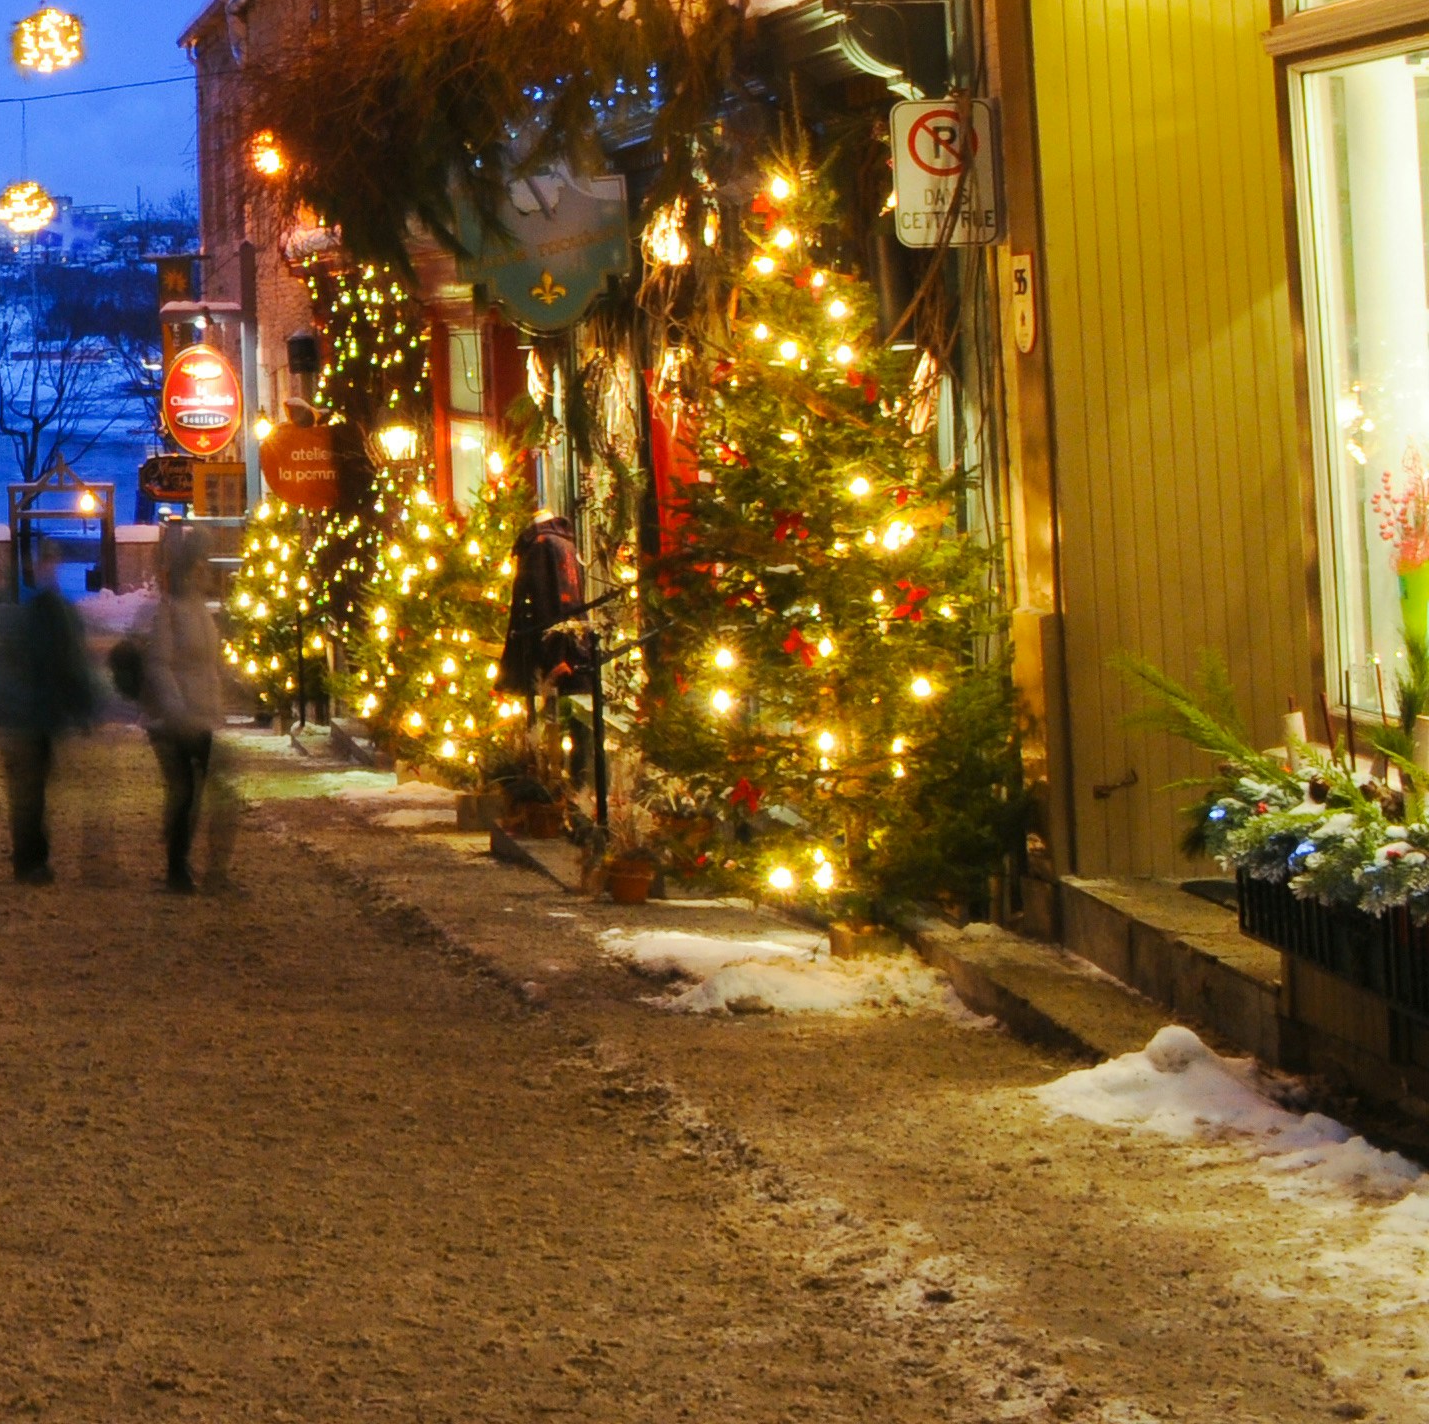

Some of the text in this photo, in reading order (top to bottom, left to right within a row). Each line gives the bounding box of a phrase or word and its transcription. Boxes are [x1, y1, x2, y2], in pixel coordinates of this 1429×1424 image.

[923, 187, 970, 206] DAS
[901, 210, 953, 230] CETT
[290, 446, 332, 461] atelie
[278, 467, 339, 482] la pomm
